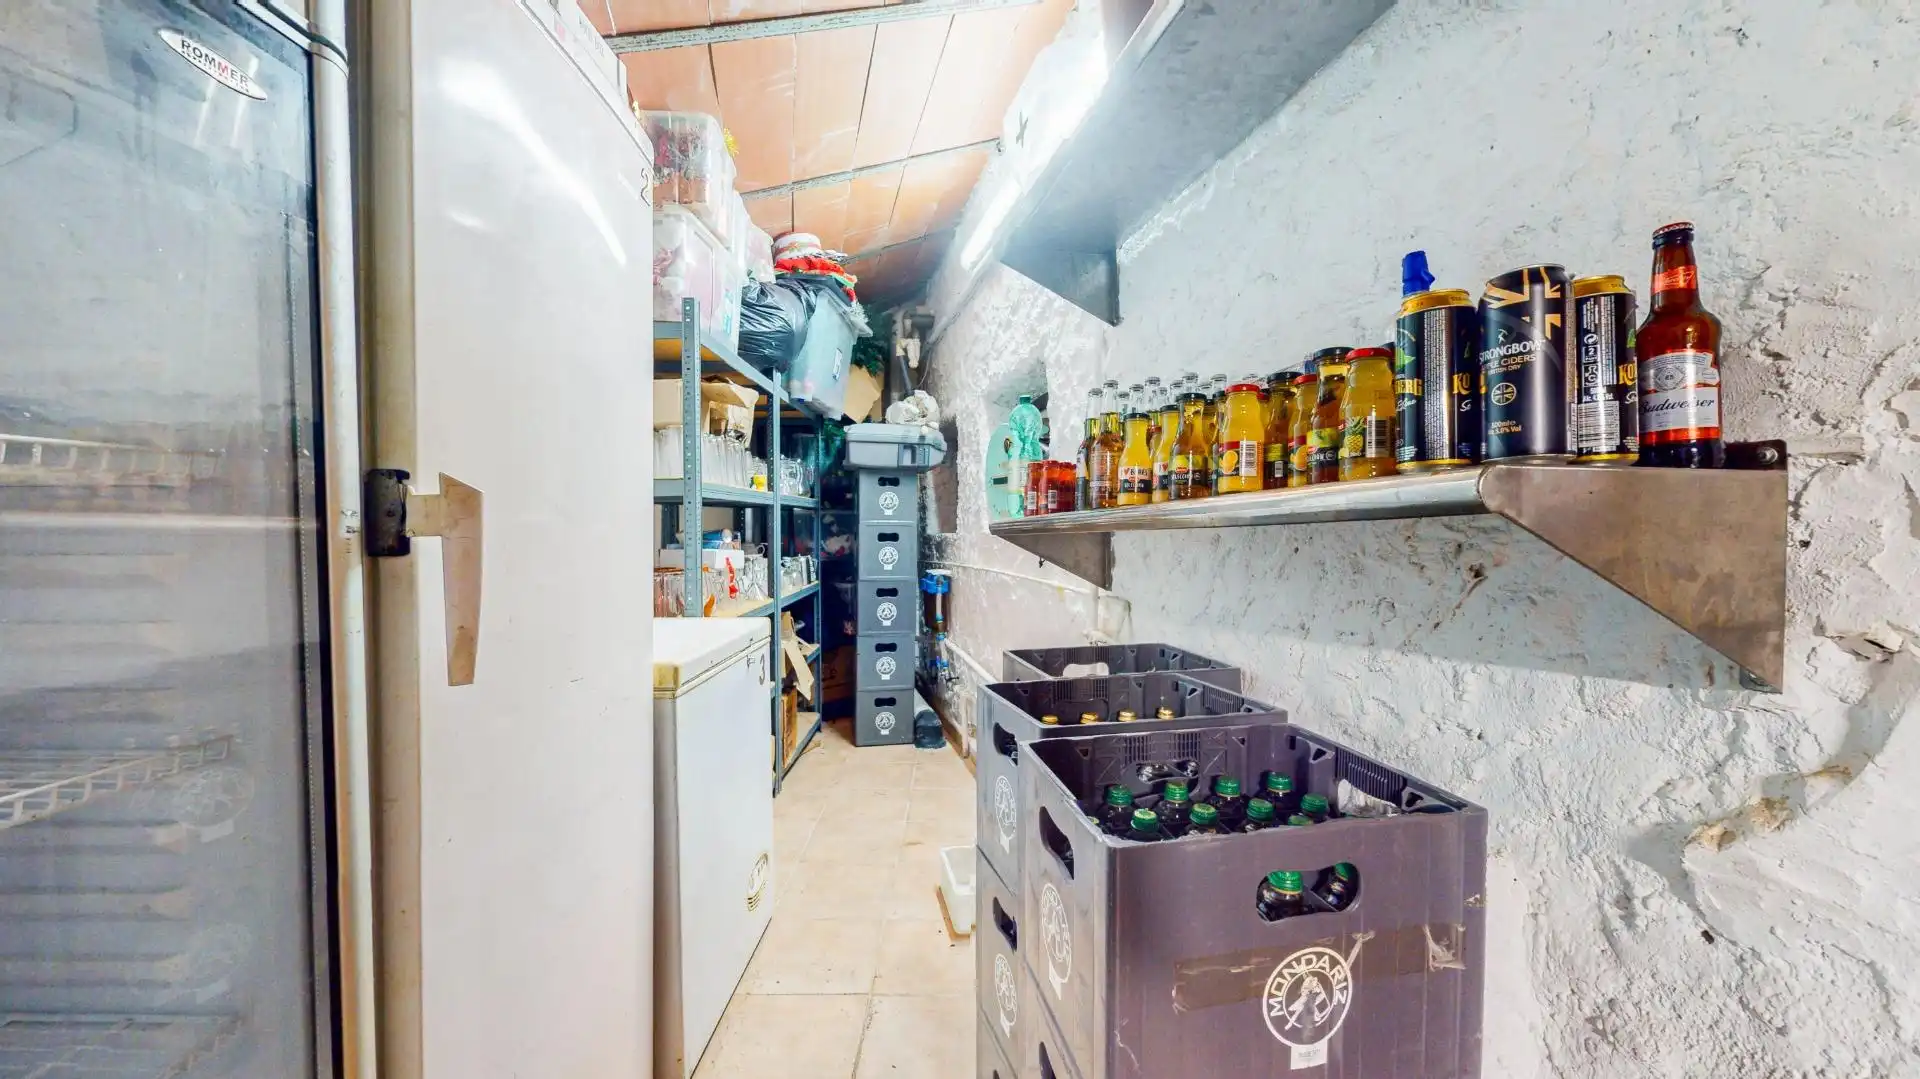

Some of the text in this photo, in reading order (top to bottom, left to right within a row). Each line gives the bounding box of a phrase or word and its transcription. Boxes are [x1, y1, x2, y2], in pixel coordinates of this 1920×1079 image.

[181, 39, 249, 88] ROMMER
[1479, 339, 1546, 364] STRONGBOW
[1501, 354, 1537, 365] CIDERS
[1268, 954, 1348, 1018] MONDARIZ
